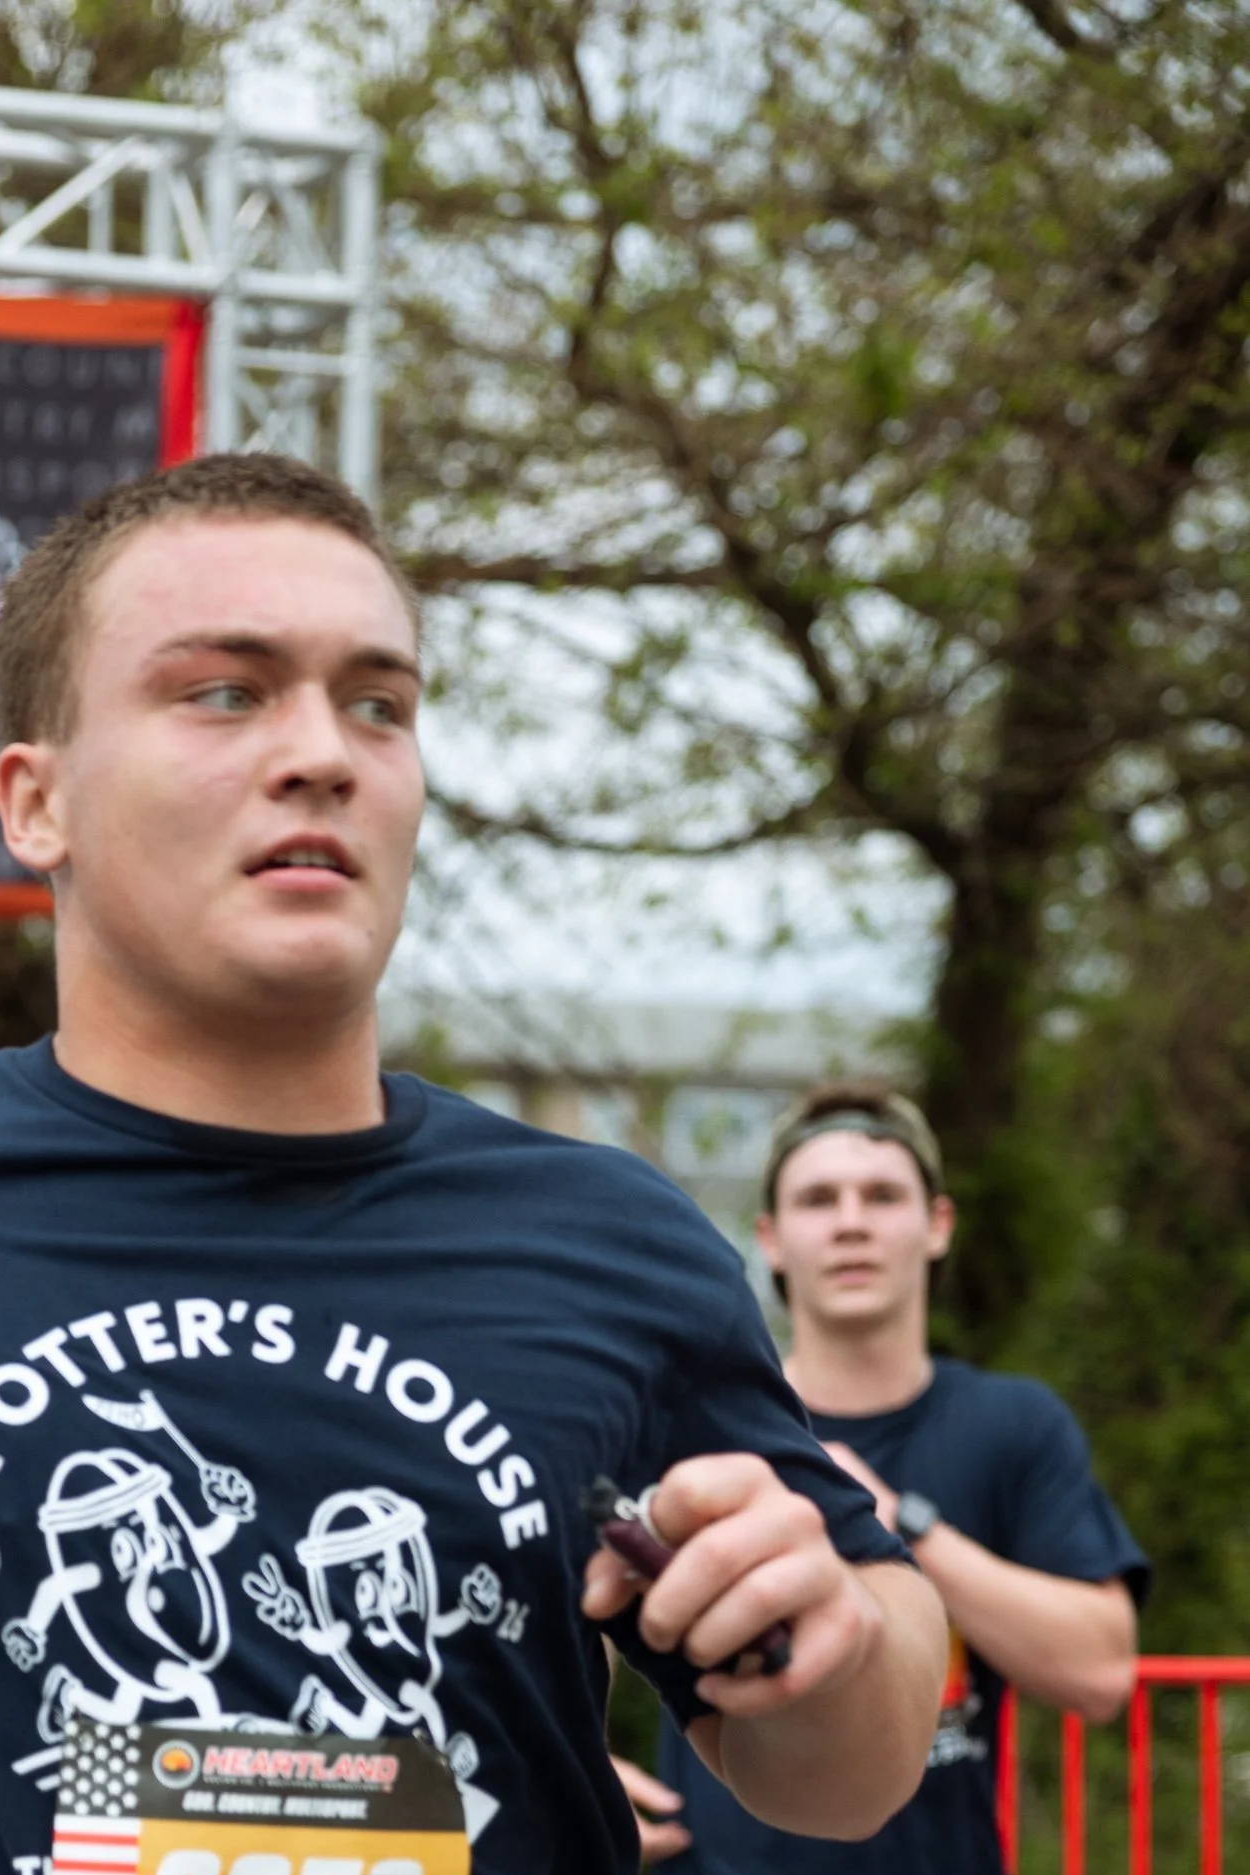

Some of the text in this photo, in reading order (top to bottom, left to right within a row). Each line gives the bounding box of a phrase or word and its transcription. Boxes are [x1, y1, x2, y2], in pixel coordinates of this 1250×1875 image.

[323, 1323, 548, 1551] HOUSE
[495, 1597, 530, 1644] 26
[202, 1745, 398, 1784] HEARTLAND
